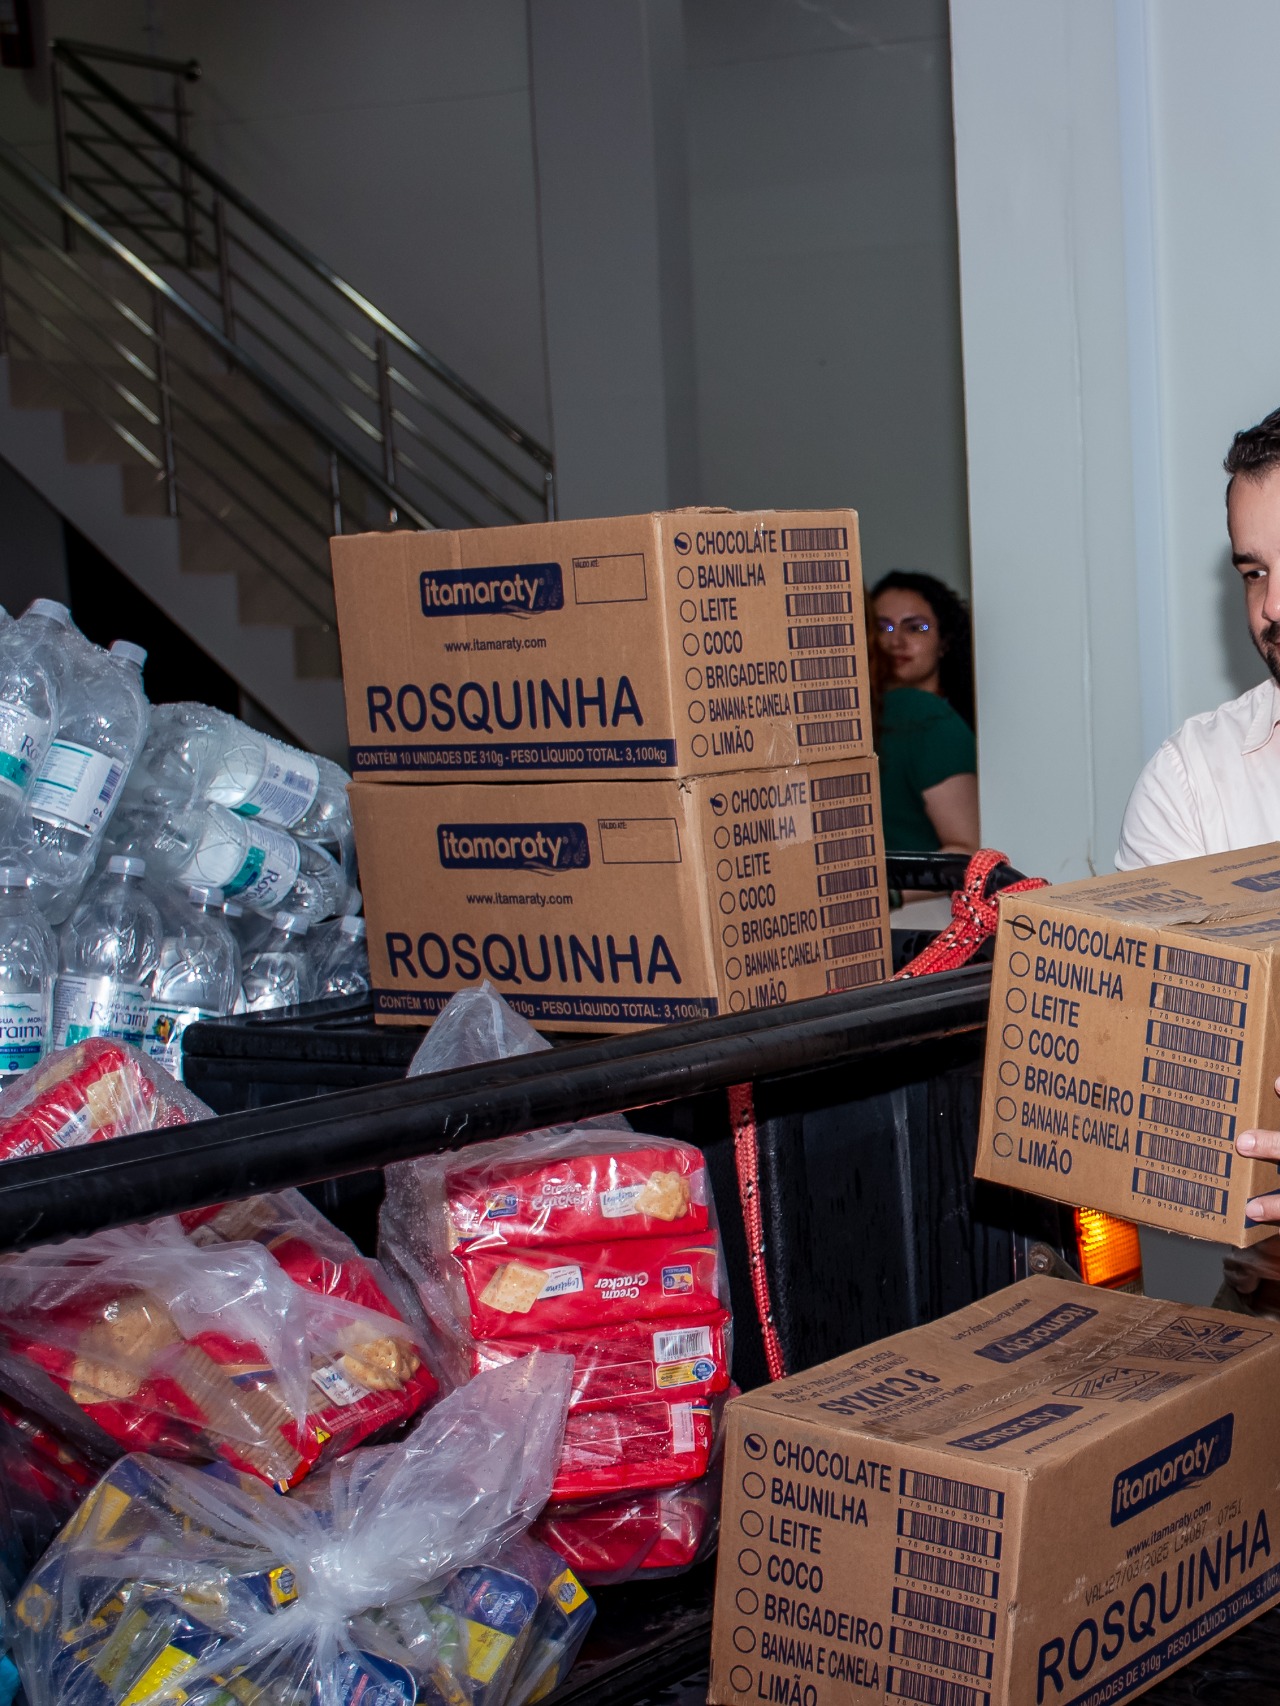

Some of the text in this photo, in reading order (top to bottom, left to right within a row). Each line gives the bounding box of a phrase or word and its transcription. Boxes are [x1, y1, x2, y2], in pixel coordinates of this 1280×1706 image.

[696, 530, 777, 555] CHOCOLATE
[424, 573, 538, 609] itamaraty
[698, 563, 766, 588] BAUNILHA
[700, 598, 738, 621] LEITE
[444, 636, 547, 653] www.itamaraty.com
[704, 630, 742, 655] COCO
[706, 660, 787, 689] BRIGADEIRO
[366, 676, 644, 734] ROSQUINHA
[709, 693, 791, 722] BANANA E CANELA
[357, 749, 398, 766] CONTÉM
[400, 752, 411, 765] 10
[413, 751, 462, 766] UNIDADES
[465, 751, 478, 764] DE
[480, 750, 504, 767] 310g
[511, 749, 538, 764] PESO
[541, 746, 583, 765] LÍQUIDO
[586, 748, 624, 763] TOTAL:
[625, 747, 667, 765] 3,100kg
[712, 725, 754, 755] LIMÃO
[732, 782, 807, 814] CHOCOLATE
[442, 830, 563, 866] itamaraty
[733, 815, 796, 846] BAUNILHA
[735, 852, 771, 879] LEITE
[466, 892, 573, 907] www.itamaraty.com
[739, 883, 776, 912] COCO
[741, 909, 817, 944] BRIGADEIRO
[1038, 919, 1147, 968] CHOCOLATE
[386, 932, 682, 984] ROSQUINHA
[744, 940, 821, 977] BANANA E CANELA
[748, 977, 787, 1008] LIMÃO
[1034, 956, 1123, 1001] BAUNILHA
[379, 992, 421, 1010] CONTÉM
[423, 997, 435, 1010] 10
[542, 1001, 572, 1015] PESO
[574, 999, 620, 1017] LÍQUIDO
[622, 1003, 662, 1017] TOTAL:
[665, 1003, 709, 1020] 3,100kg
[1031, 992, 1080, 1028] LEITE
[1028, 1029, 1080, 1064] COCO
[1024, 1065, 1134, 1116] BRIGADEIRO
[1021, 1101, 1129, 1153] BANANA E CANELA
[1018, 1137, 1072, 1175] LIMÃO
[594, 1272, 649, 1289] Cracker
[601, 1287, 640, 1299] Cream
[997, 1305, 1091, 1354] itamaraty
[905, 1368, 941, 1383] 8
[818, 1377, 921, 1416] CAIXAS
[773, 1439, 892, 1493] CHOCOLATE
[1115, 1436, 1215, 1514] itamaraty
[771, 1477, 868, 1527] BAUNILHA
[769, 1515, 822, 1554] LEITE
[1126, 1500, 1212, 1559] www.itamaraty.com
[767, 1555, 823, 1593] COCO
[764, 1593, 883, 1650] BRIGADEIRO
[1036, 1508, 1271, 1706] ROSQUINHA
[1126, 1672, 1139, 1688] DE
[1140, 1655, 1162, 1675] 310g
[1167, 1636, 1192, 1660] PESO
[1192, 1614, 1227, 1644] LÍQUIDO
[1227, 1598, 1255, 1621] TOTAL:
[761, 1632, 880, 1690] BANANA E CANELA
[757, 1671, 818, 1706] LIMÃO
